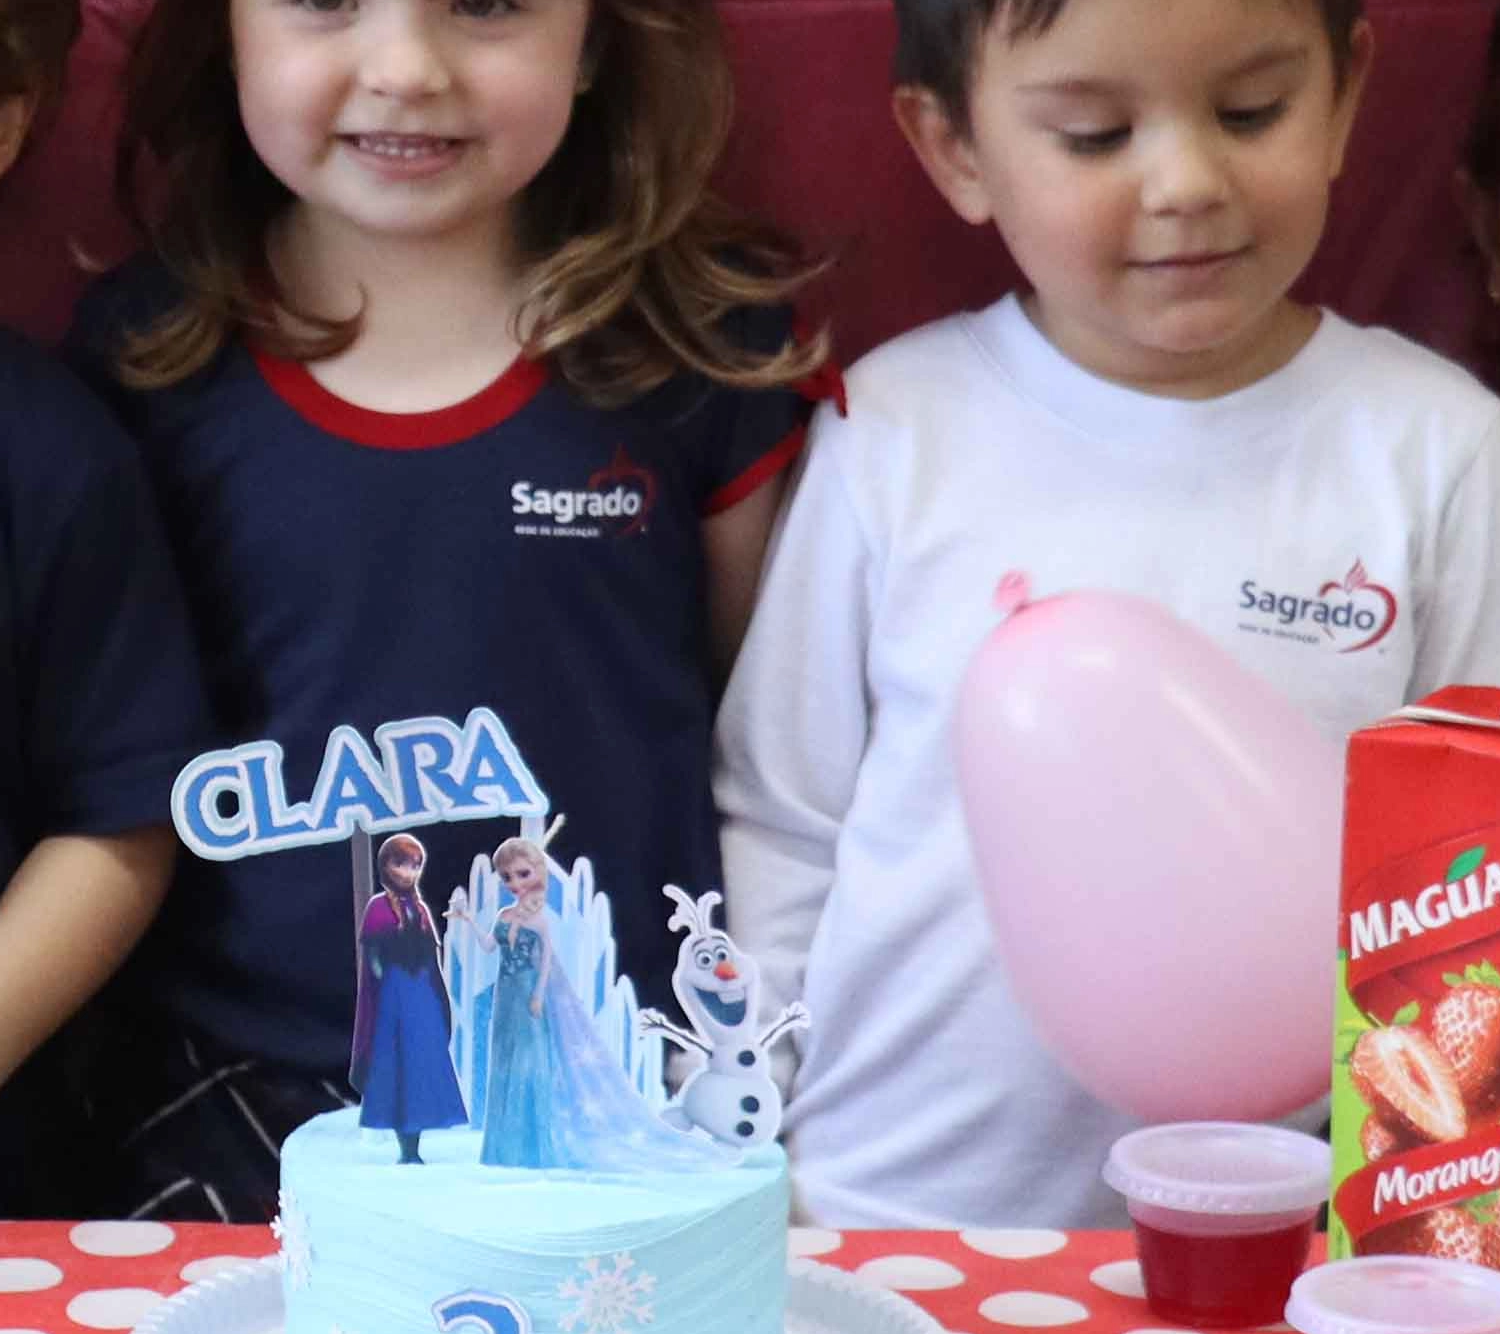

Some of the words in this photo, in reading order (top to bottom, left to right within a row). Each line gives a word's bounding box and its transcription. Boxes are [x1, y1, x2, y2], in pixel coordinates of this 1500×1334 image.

[511, 479, 641, 524] Sagrado
[1239, 579, 1376, 632] Sagrado
[179, 716, 540, 853] CLARA
